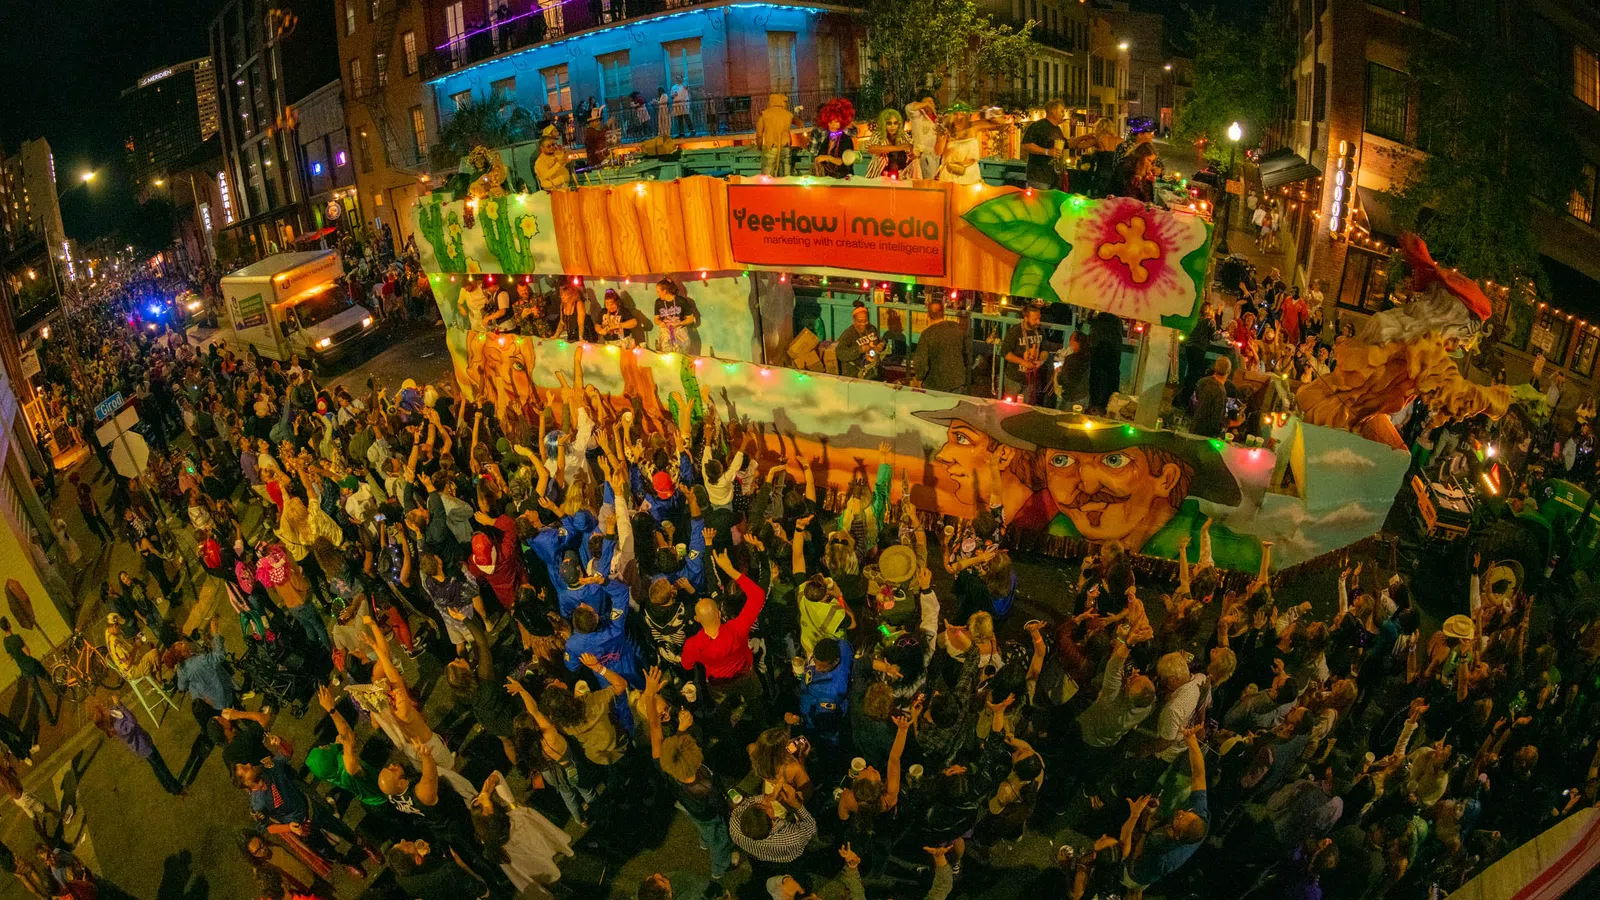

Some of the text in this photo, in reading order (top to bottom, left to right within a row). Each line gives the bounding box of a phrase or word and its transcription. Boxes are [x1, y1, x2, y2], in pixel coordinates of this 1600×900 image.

[219, 172, 233, 223] CAMBRIA
[202, 207, 212, 230] PARK
[733, 207, 939, 240] Yee-Haw media
[763, 235, 939, 255] marketing with creative intelligence
[101, 395, 123, 415] Girod
